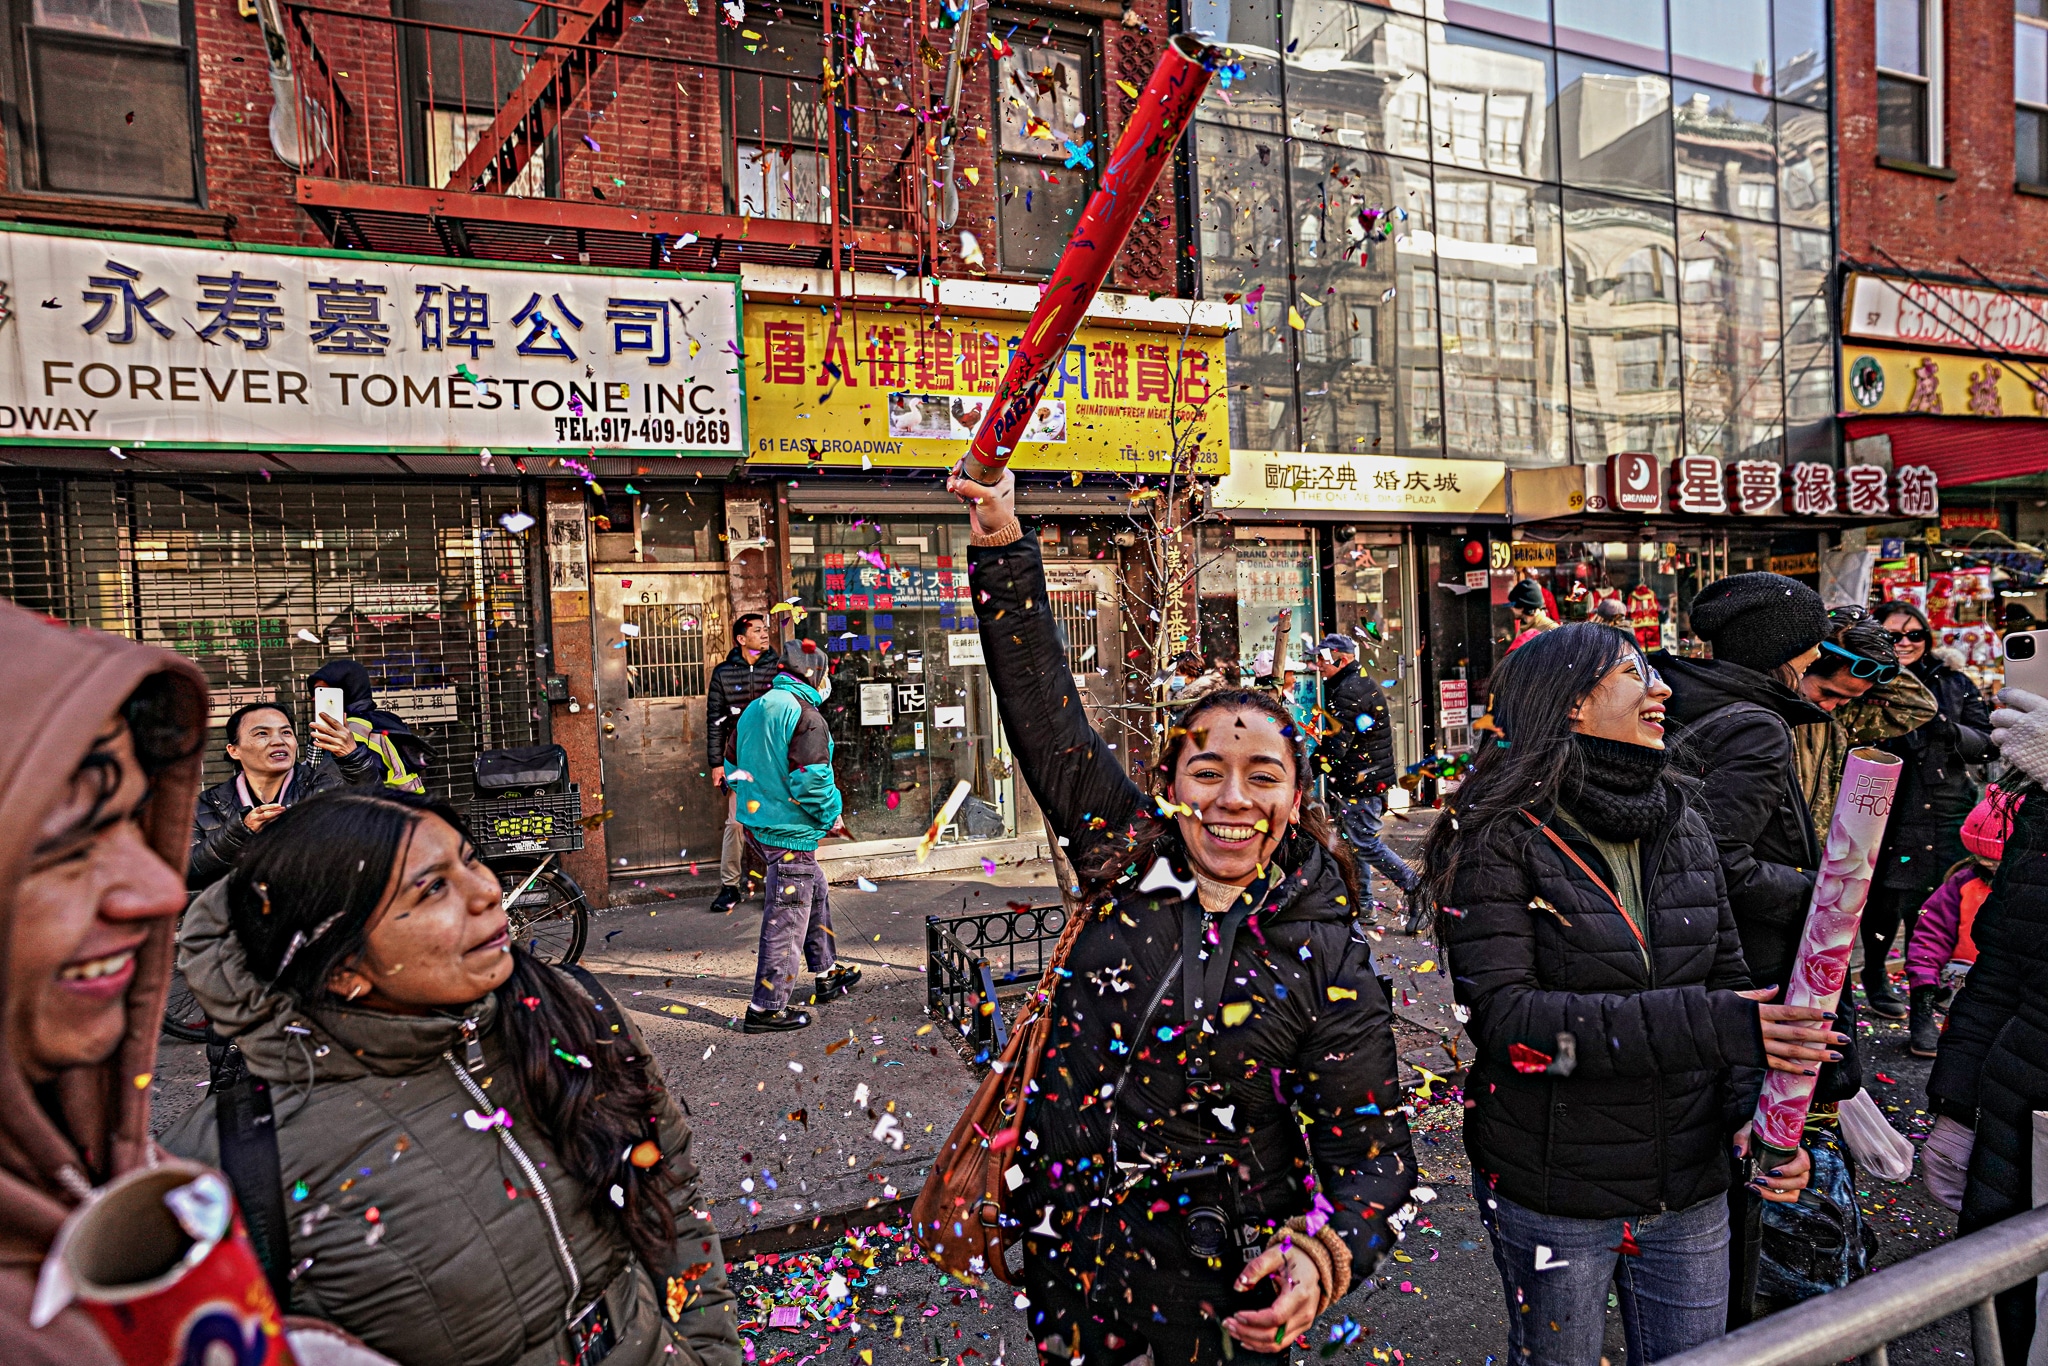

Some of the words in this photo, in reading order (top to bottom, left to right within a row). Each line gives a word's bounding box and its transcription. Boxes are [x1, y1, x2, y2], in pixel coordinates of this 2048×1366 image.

[82, 260, 673, 367] 永寿墓碑公司
[763, 320, 1210, 404] 唐人街鷄鴨丸雜貨店
[43, 360, 309, 407] FOREVER
[330, 371, 628, 413] TOMESTONE
[643, 382, 726, 416] INC.
[1075, 404, 1121, 417] CHINATOWN
[1123, 406, 1145, 418] FRESH
[1147, 408, 1166, 420] MEAT
[555, 416, 730, 445] TEL:917-409-0269
[759, 438, 774, 452] 61
[780, 438, 818, 453] EAST
[823, 439, 904, 454] BROADWAY
[1300, 490, 1322, 502] THE
[1405, 493, 1436, 505] PLAZA
[1570, 494, 1582, 506] 59
[1591, 498, 1602, 510] 59
[1236, 550, 1267, 559] GRAND
[1270, 549, 1309, 559] OPENING
[1491, 541, 1511, 569] 59
[1247, 559, 1274, 569] Dental
[641, 591, 660, 604] 61
